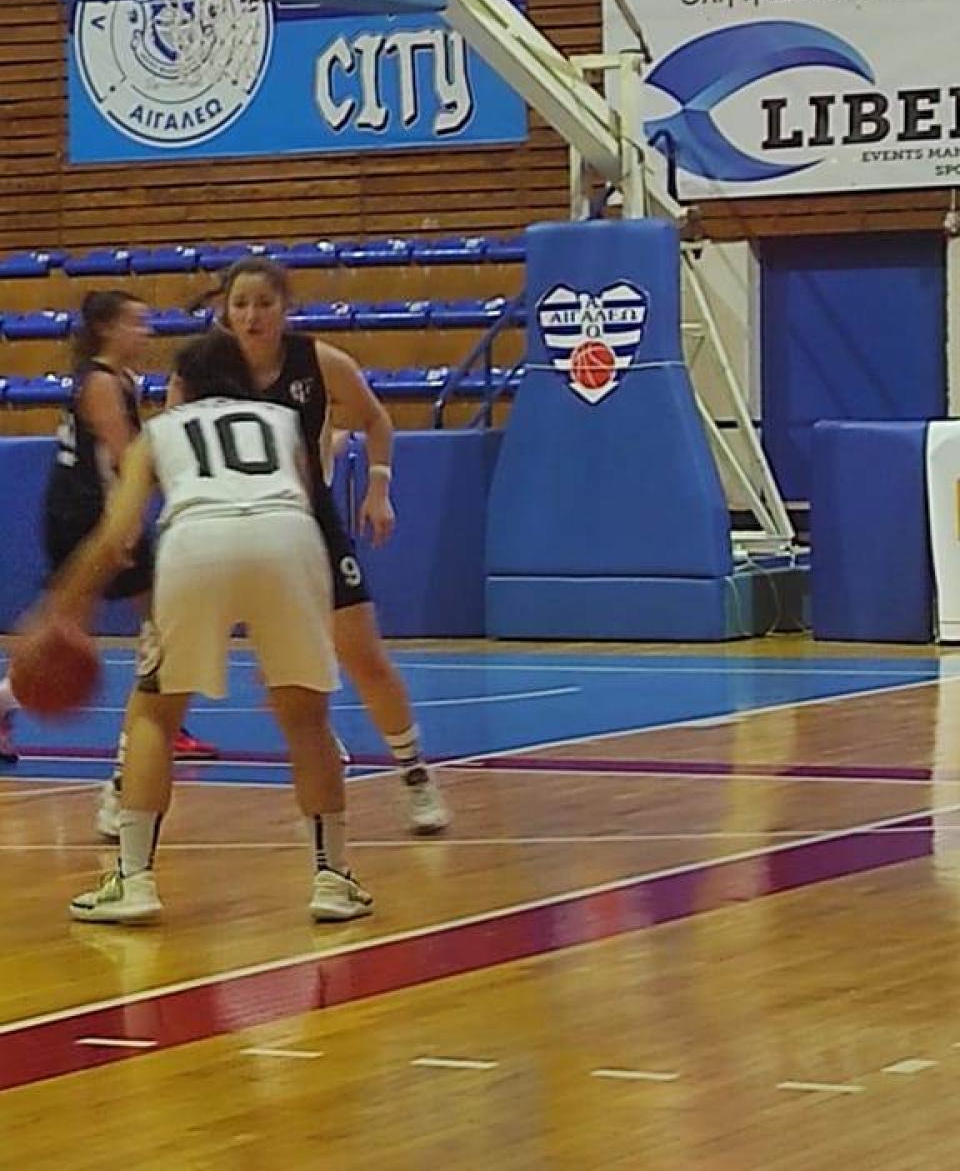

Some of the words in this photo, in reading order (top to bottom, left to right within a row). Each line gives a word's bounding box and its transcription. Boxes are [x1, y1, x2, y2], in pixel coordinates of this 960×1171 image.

[128, 97, 224, 132] ΑΙΓΑΛΕΩ
[861, 149, 923, 163] EVENTS
[183, 411, 281, 479] 10
[340, 555, 362, 587] 9
